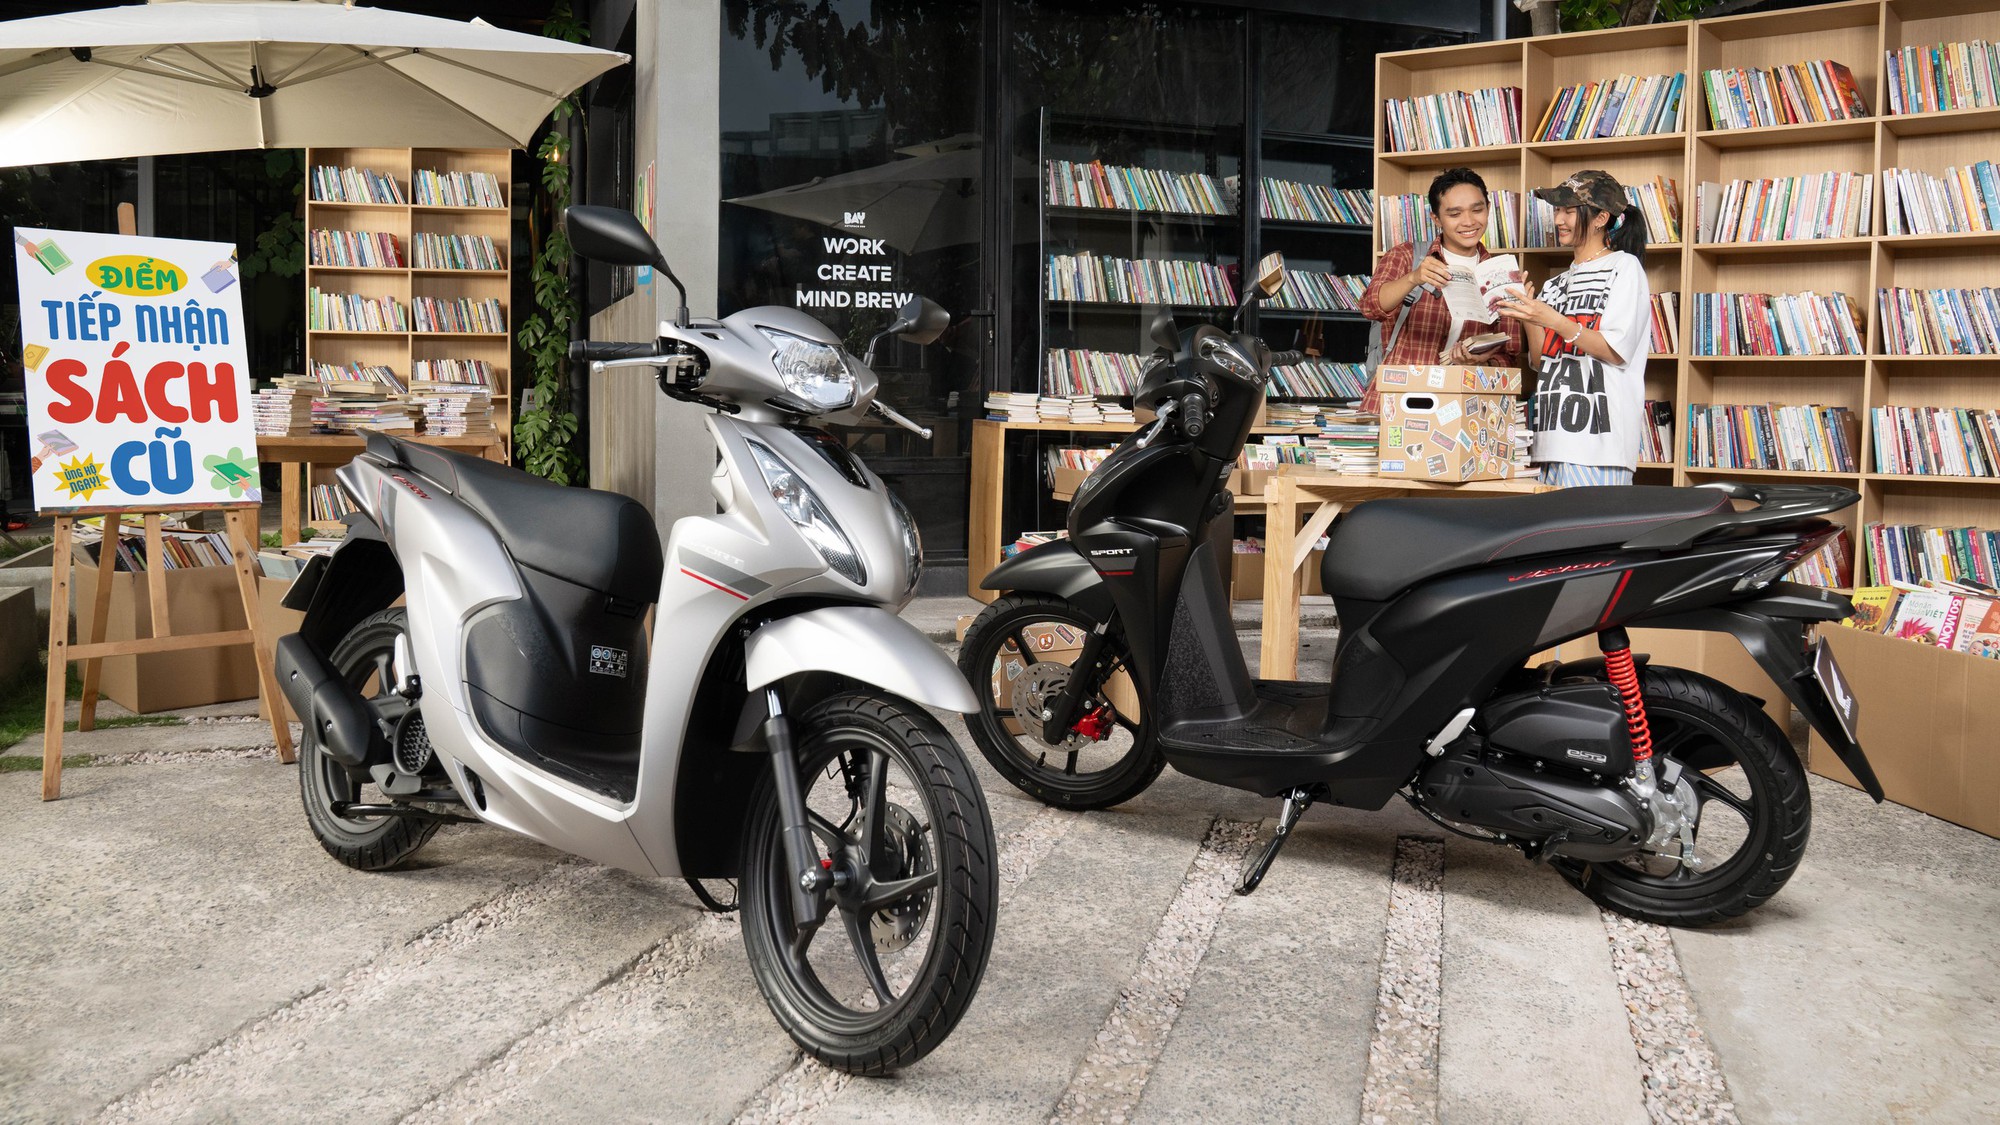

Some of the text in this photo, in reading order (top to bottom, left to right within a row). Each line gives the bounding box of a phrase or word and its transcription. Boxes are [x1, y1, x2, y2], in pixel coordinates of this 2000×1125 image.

[843, 211, 866, 225] BAY
[823, 237, 886, 255] WORK
[98, 258, 179, 292] ĐIỂM
[817, 264, 892, 282] CREATE
[796, 290, 914, 309] MIND BREW
[41, 290, 229, 351] TIẾP NHẬN
[45, 341, 239, 424] SÁCH
[110, 427, 194, 496] CŨ
[69, 475, 102, 493] NGAY!
[1090, 548, 1133, 556] SPORT
[1949, 599, 1962, 614] 60
[1939, 614, 1958, 645] MÓN
